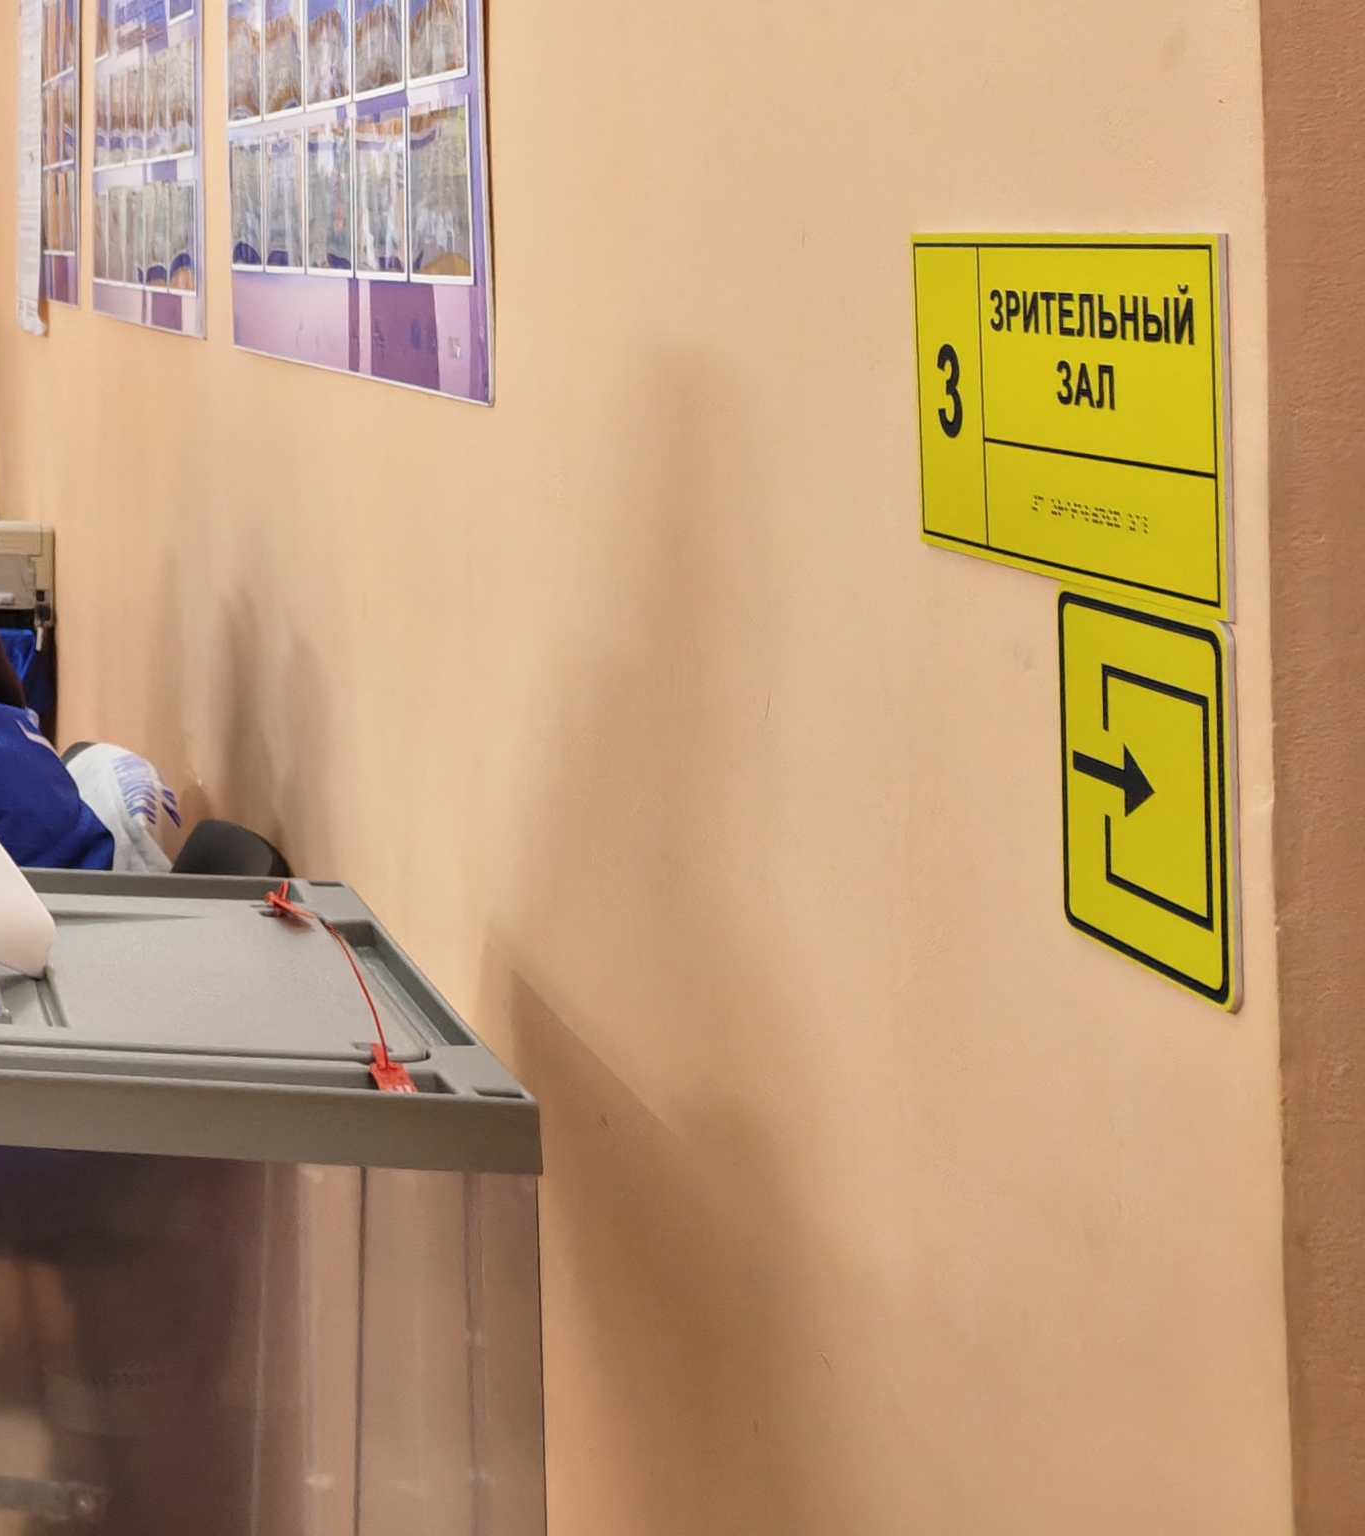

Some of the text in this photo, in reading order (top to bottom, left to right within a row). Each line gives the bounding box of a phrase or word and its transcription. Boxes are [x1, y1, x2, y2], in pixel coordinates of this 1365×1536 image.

[989, 284, 1195, 346] ЗРИТЕЛЬНЫЙ
[936, 343, 964, 439] 3
[1055, 359, 1116, 411] ЗАЛ
